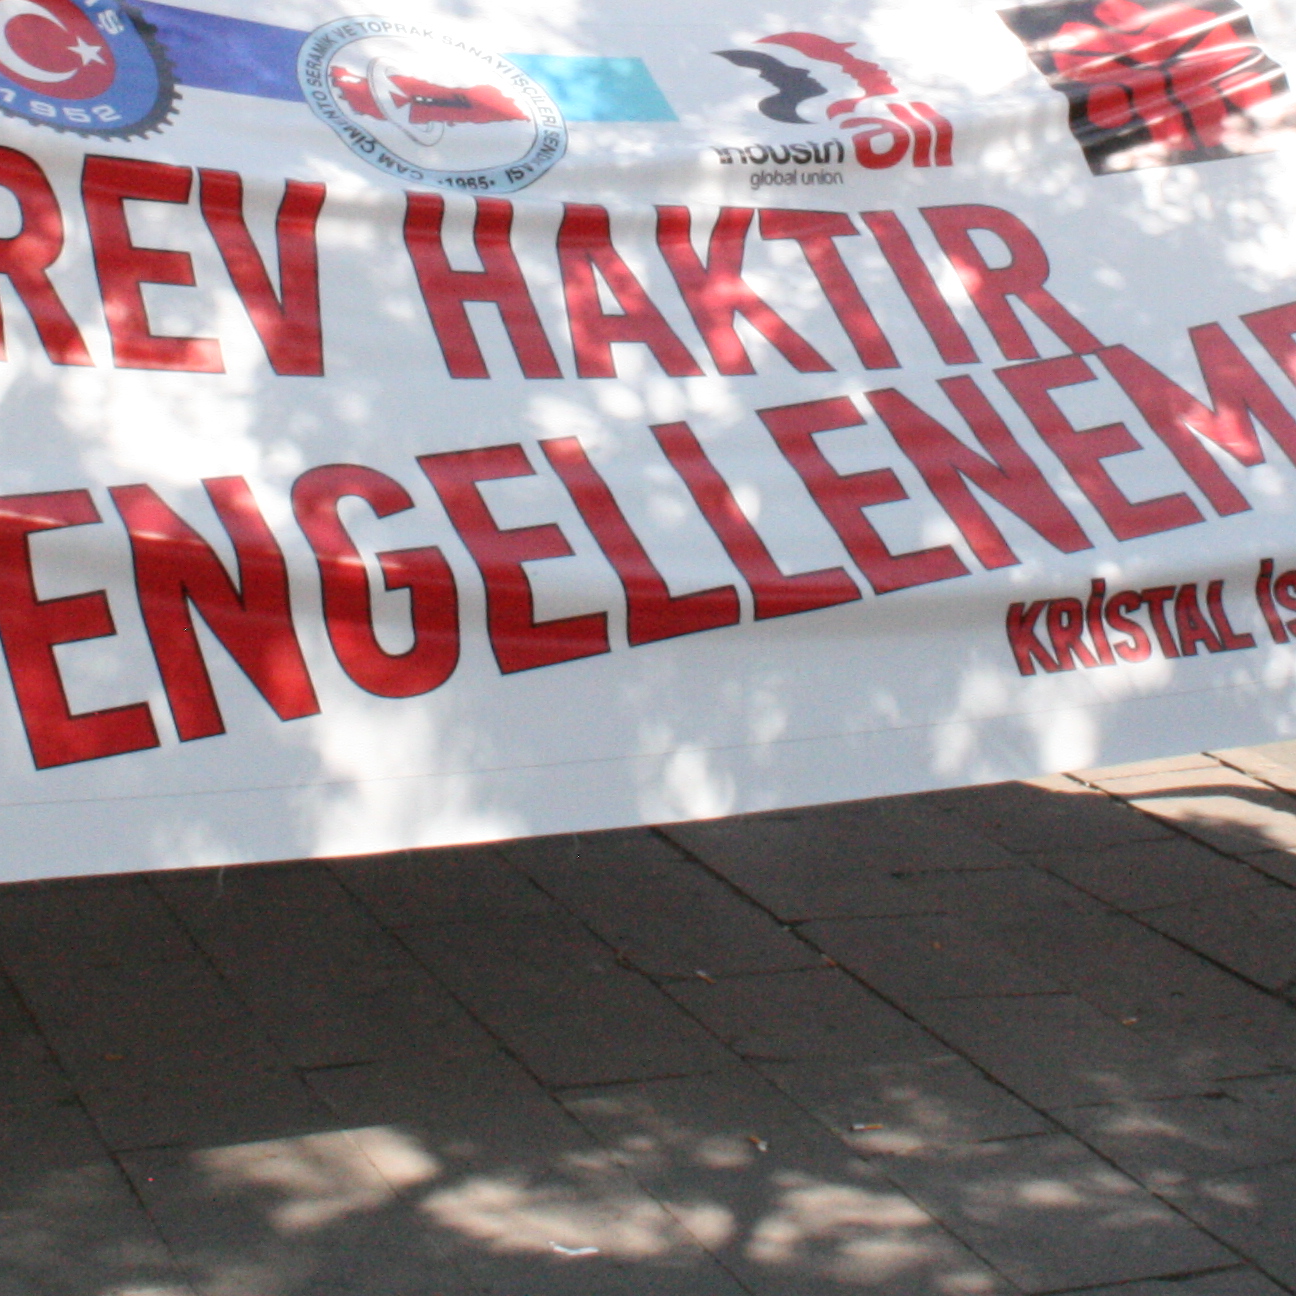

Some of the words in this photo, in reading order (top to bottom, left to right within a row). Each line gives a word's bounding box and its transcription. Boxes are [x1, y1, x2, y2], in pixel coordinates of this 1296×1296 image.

[750, 167, 797, 191] global
[803, 167, 844, 186] union
[402, 191, 1109, 380] HAKTIR
[1005, 578, 1257, 677] KRİSTAL
